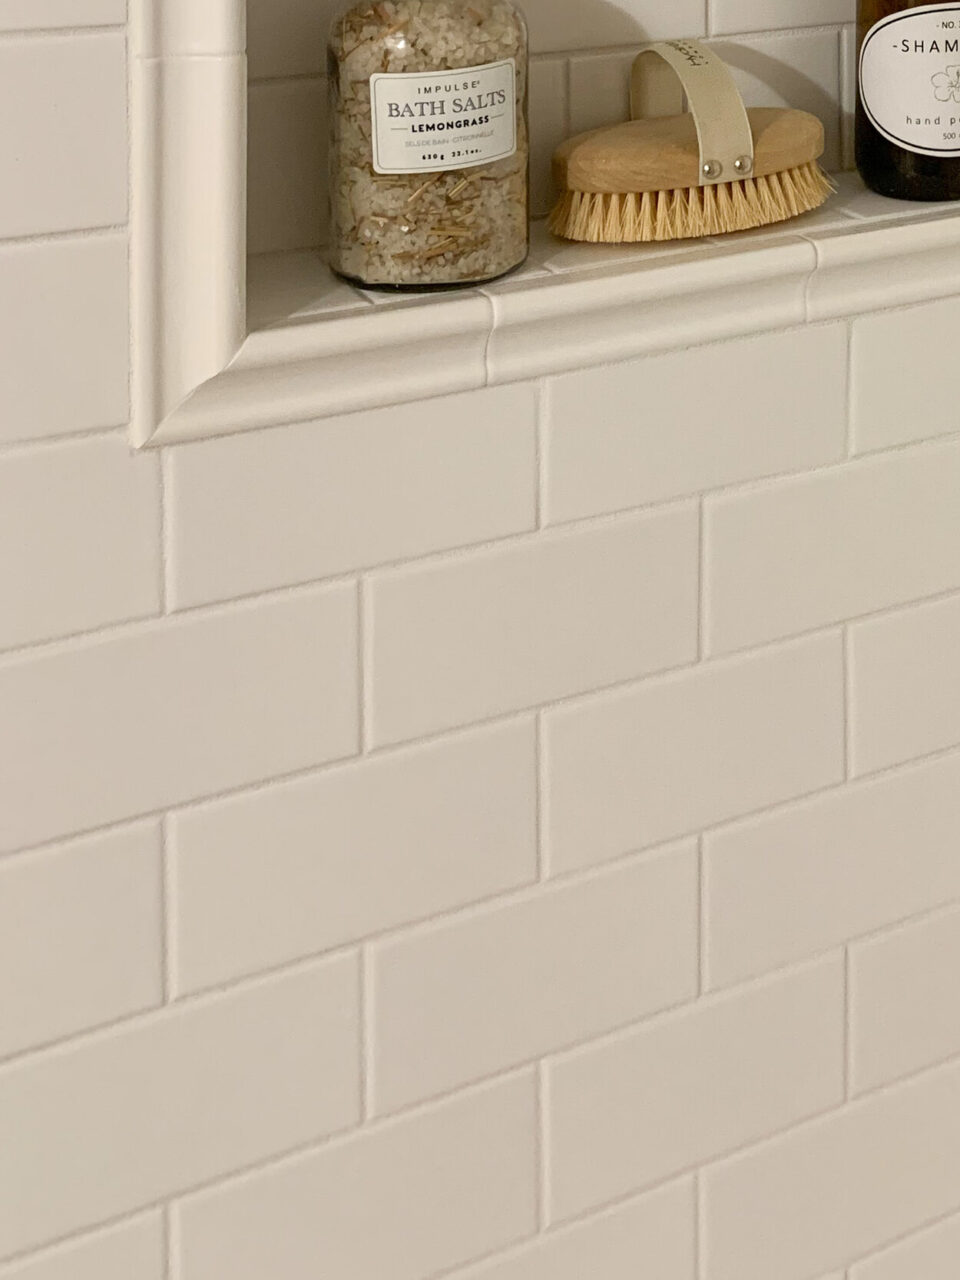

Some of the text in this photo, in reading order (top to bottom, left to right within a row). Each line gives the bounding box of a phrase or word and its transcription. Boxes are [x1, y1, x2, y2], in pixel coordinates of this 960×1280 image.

[942, 21, 956, 29] NO.
[388, 90, 506, 118] BATH SALTS
[412, 115, 490, 133] LEMONGRASS
[906, 116, 940, 126] hand
[943, 132, 956, 140] 500
